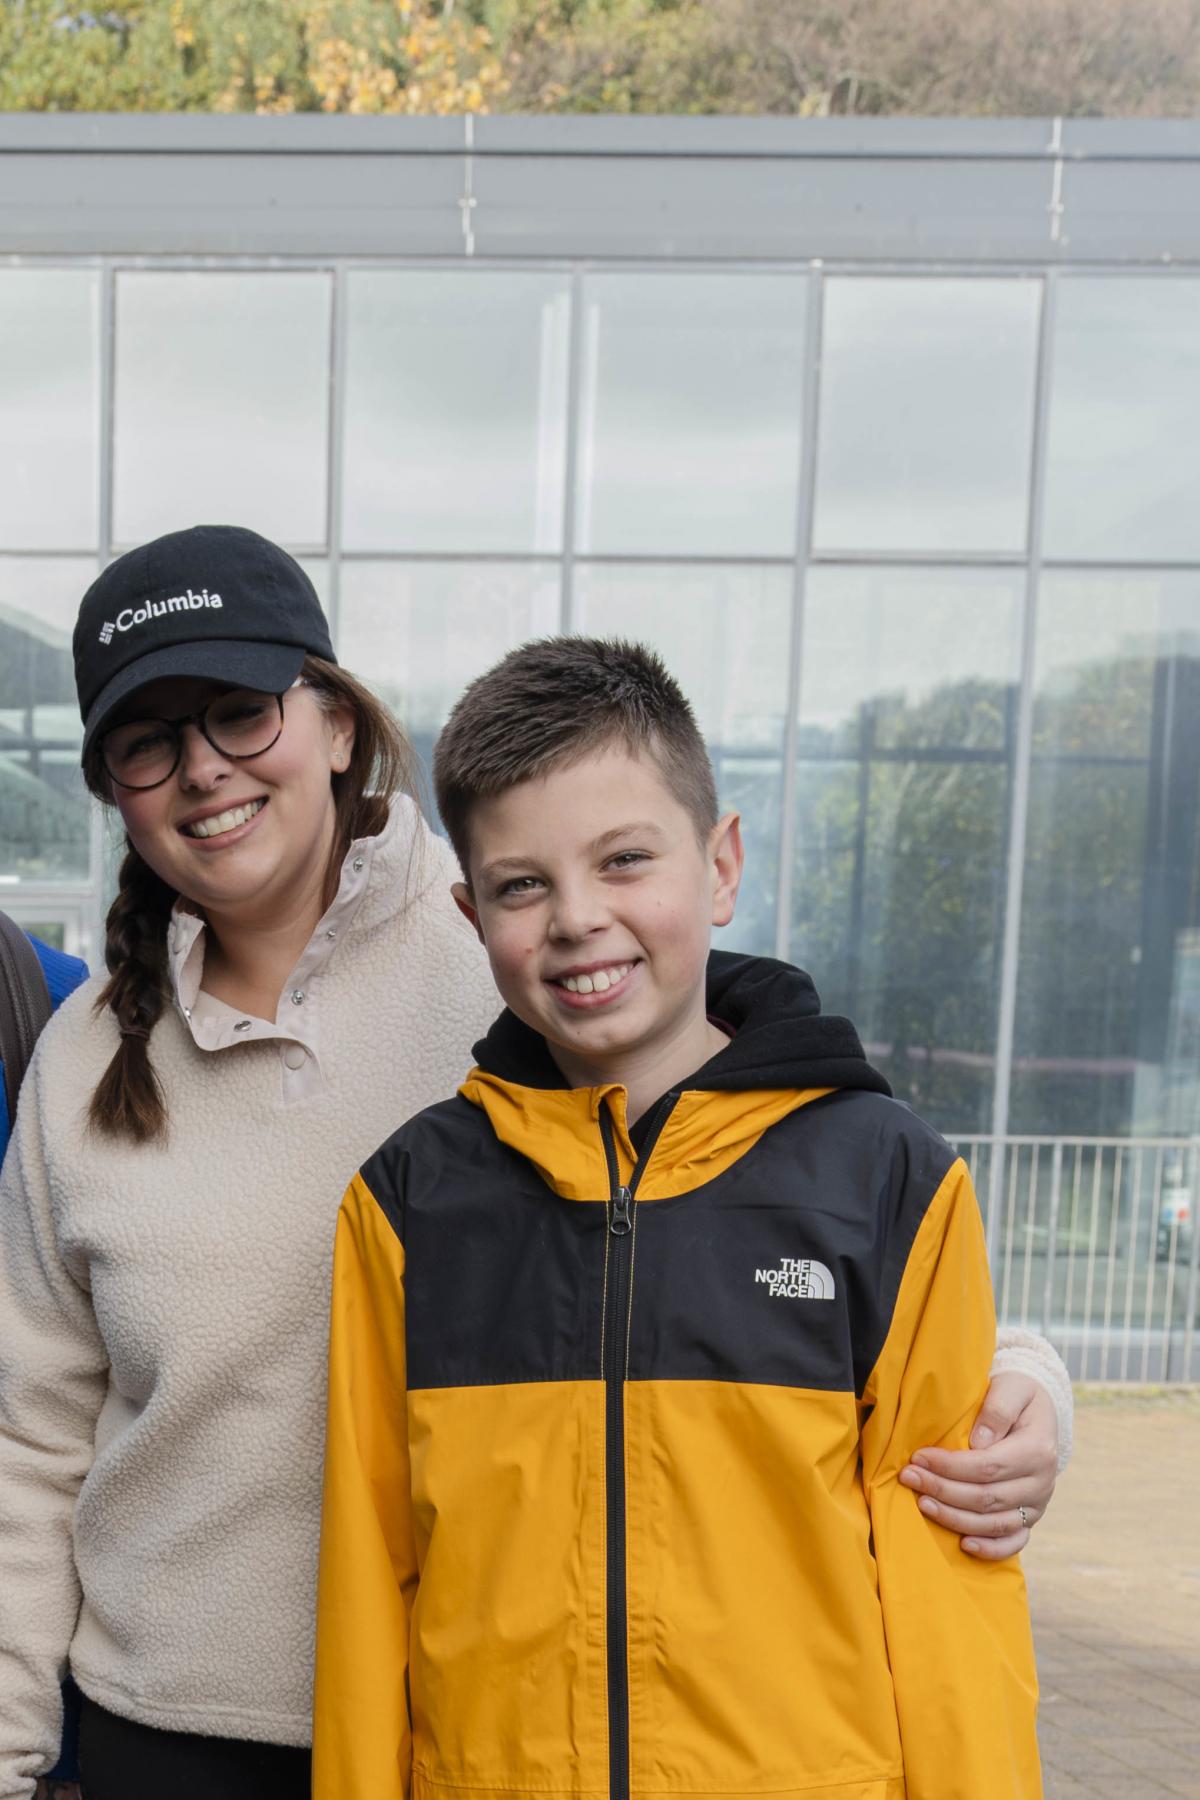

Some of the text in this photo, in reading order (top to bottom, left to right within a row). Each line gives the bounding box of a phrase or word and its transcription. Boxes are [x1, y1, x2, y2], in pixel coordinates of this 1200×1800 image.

[115, 589, 223, 632] Columbia
[780, 1258, 811, 1273] THE
[755, 1269, 810, 1285] NORTH
[769, 1283, 809, 1298] FACE
